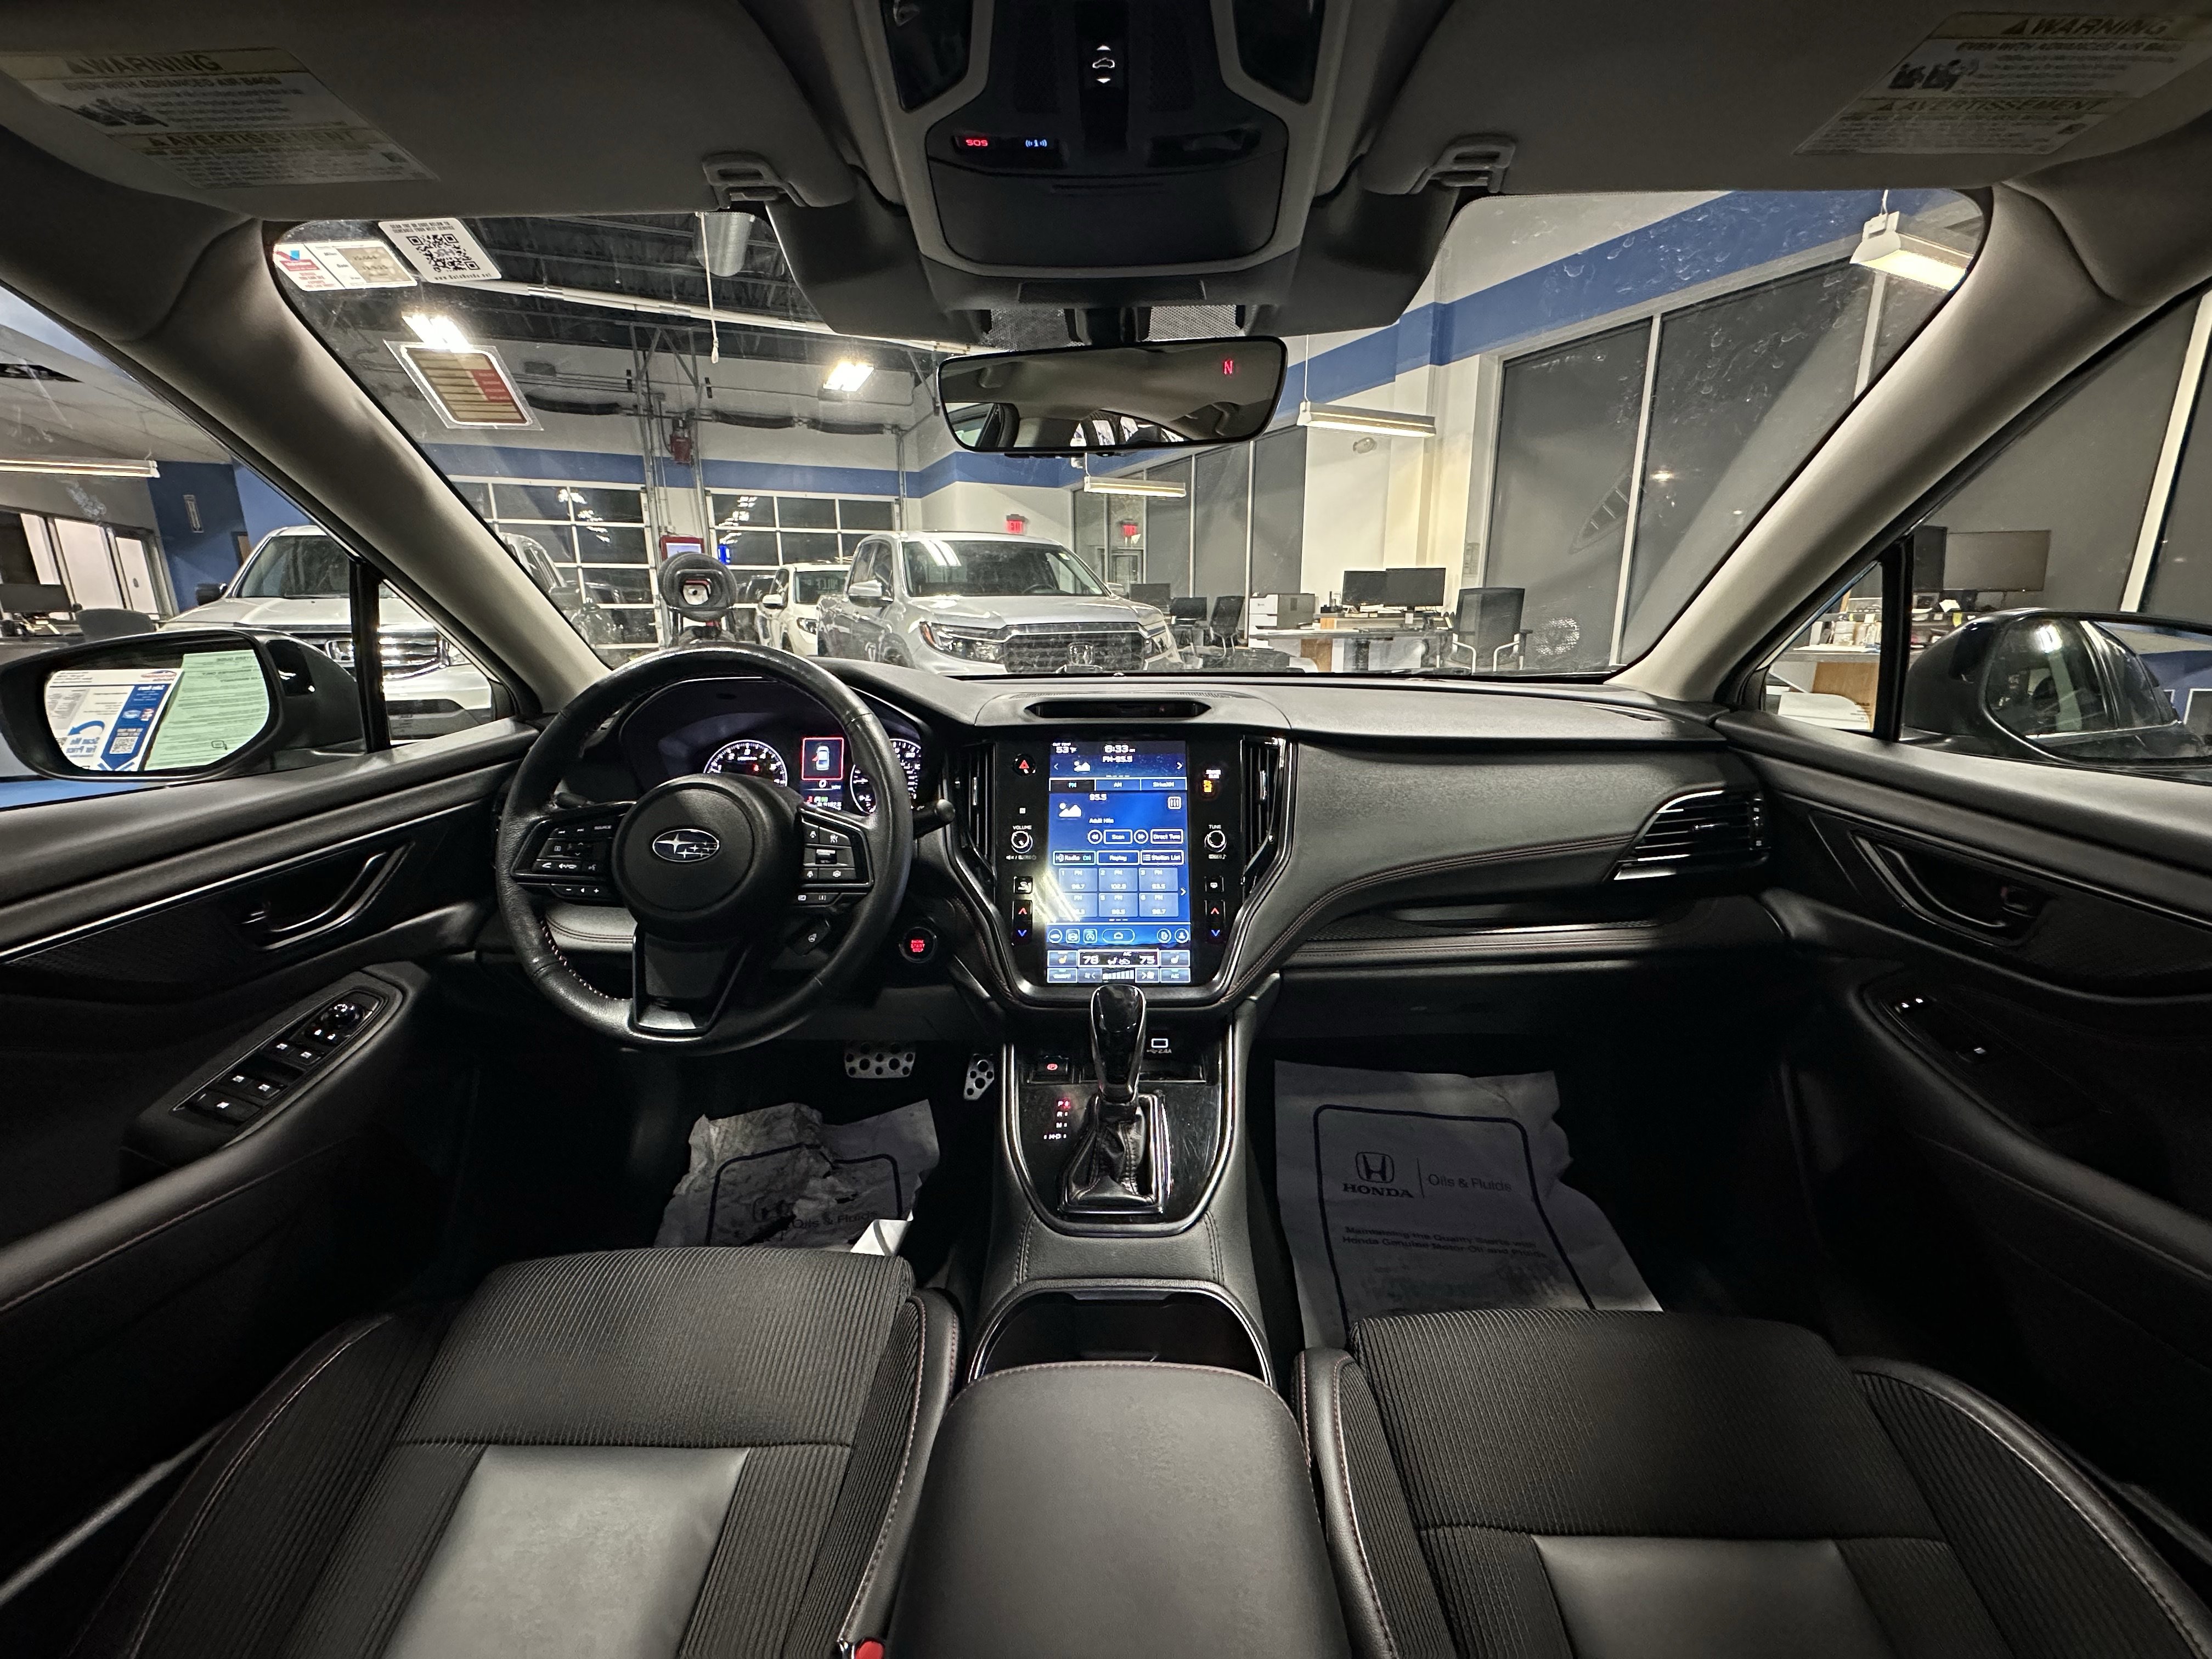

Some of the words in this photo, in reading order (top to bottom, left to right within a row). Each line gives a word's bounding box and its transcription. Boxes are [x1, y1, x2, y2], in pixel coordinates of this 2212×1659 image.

[2031, 18, 2169, 35] WARNING
[81, 54, 223, 74] WARNING
[166, 131, 356, 146] AVERTISSEMENT
[966, 139, 988, 147] SOS
[1222, 360, 1234, 375] N
[1081, 955, 1100, 964] 78
[1138, 955, 1155, 964] 75
[1342, 1183, 1414, 1199] HONDA
[1428, 1173, 1455, 1188] Oils
[1459, 1177, 1469, 1188] &
[1471, 1177, 1513, 1193] Fluids
[837, 1210, 878, 1224] Fluids
[1342, 1236, 1380, 1246] Honda
[1382, 1238, 1430, 1249] Genuine
[1432, 1242, 1465, 1252] Motor
[1468, 1244, 1485, 1253] Oil
[1487, 1246, 1510, 1255] and
[1412, 1232, 1432, 1240] the
[1433, 1233, 1473, 1244] Quality
